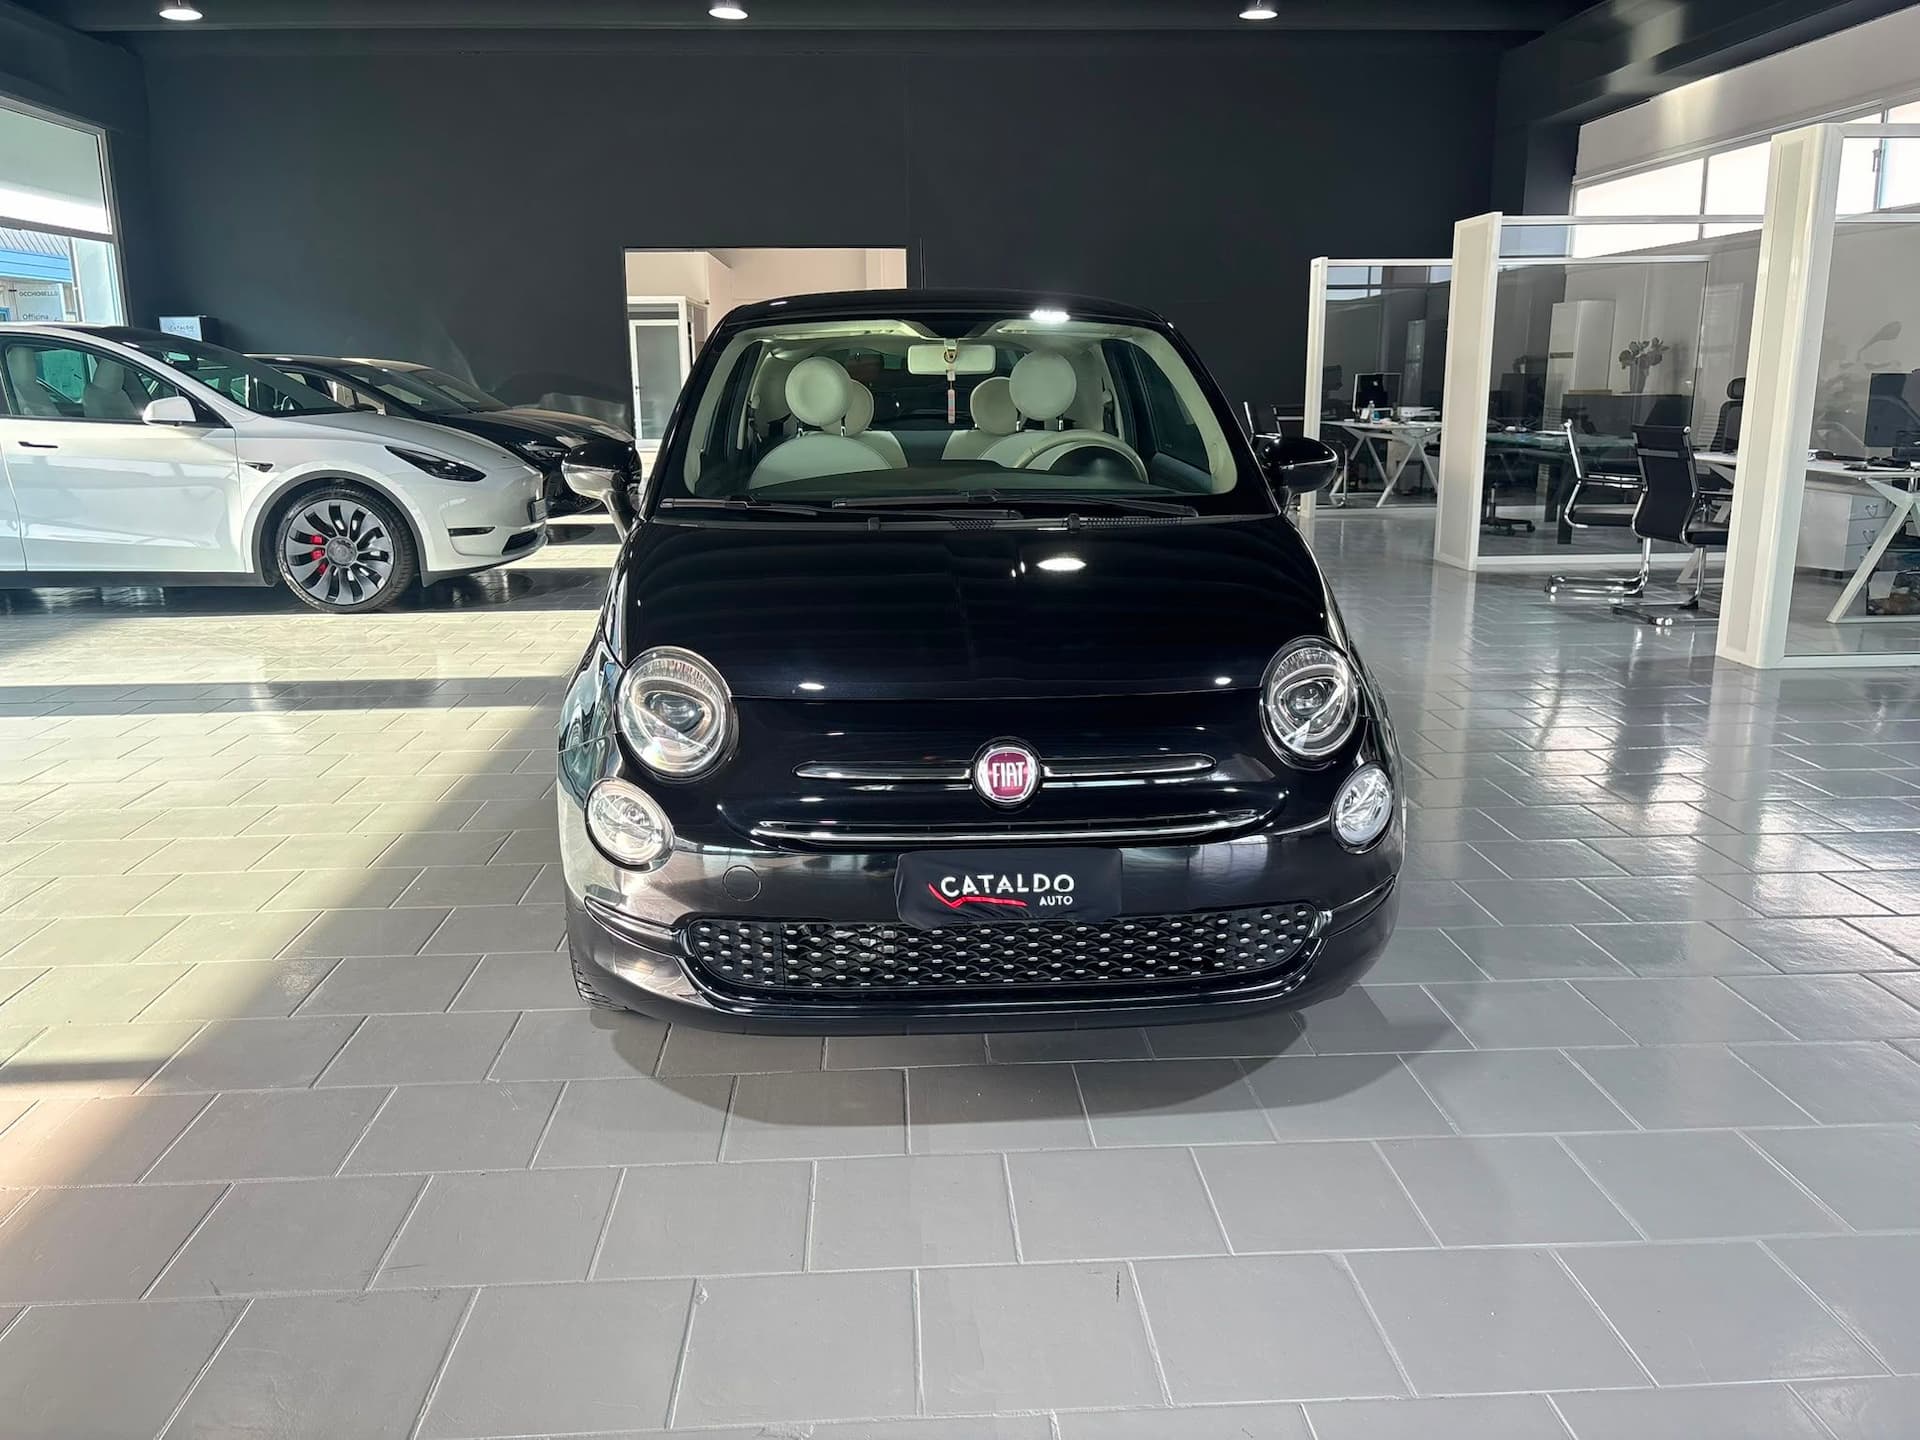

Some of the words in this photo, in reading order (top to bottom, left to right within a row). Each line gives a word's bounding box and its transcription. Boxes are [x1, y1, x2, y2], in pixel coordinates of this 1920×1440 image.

[991, 761, 1026, 789] FIAT
[940, 873, 1075, 898] CATALDO
[1039, 895, 1074, 907] AUTO
